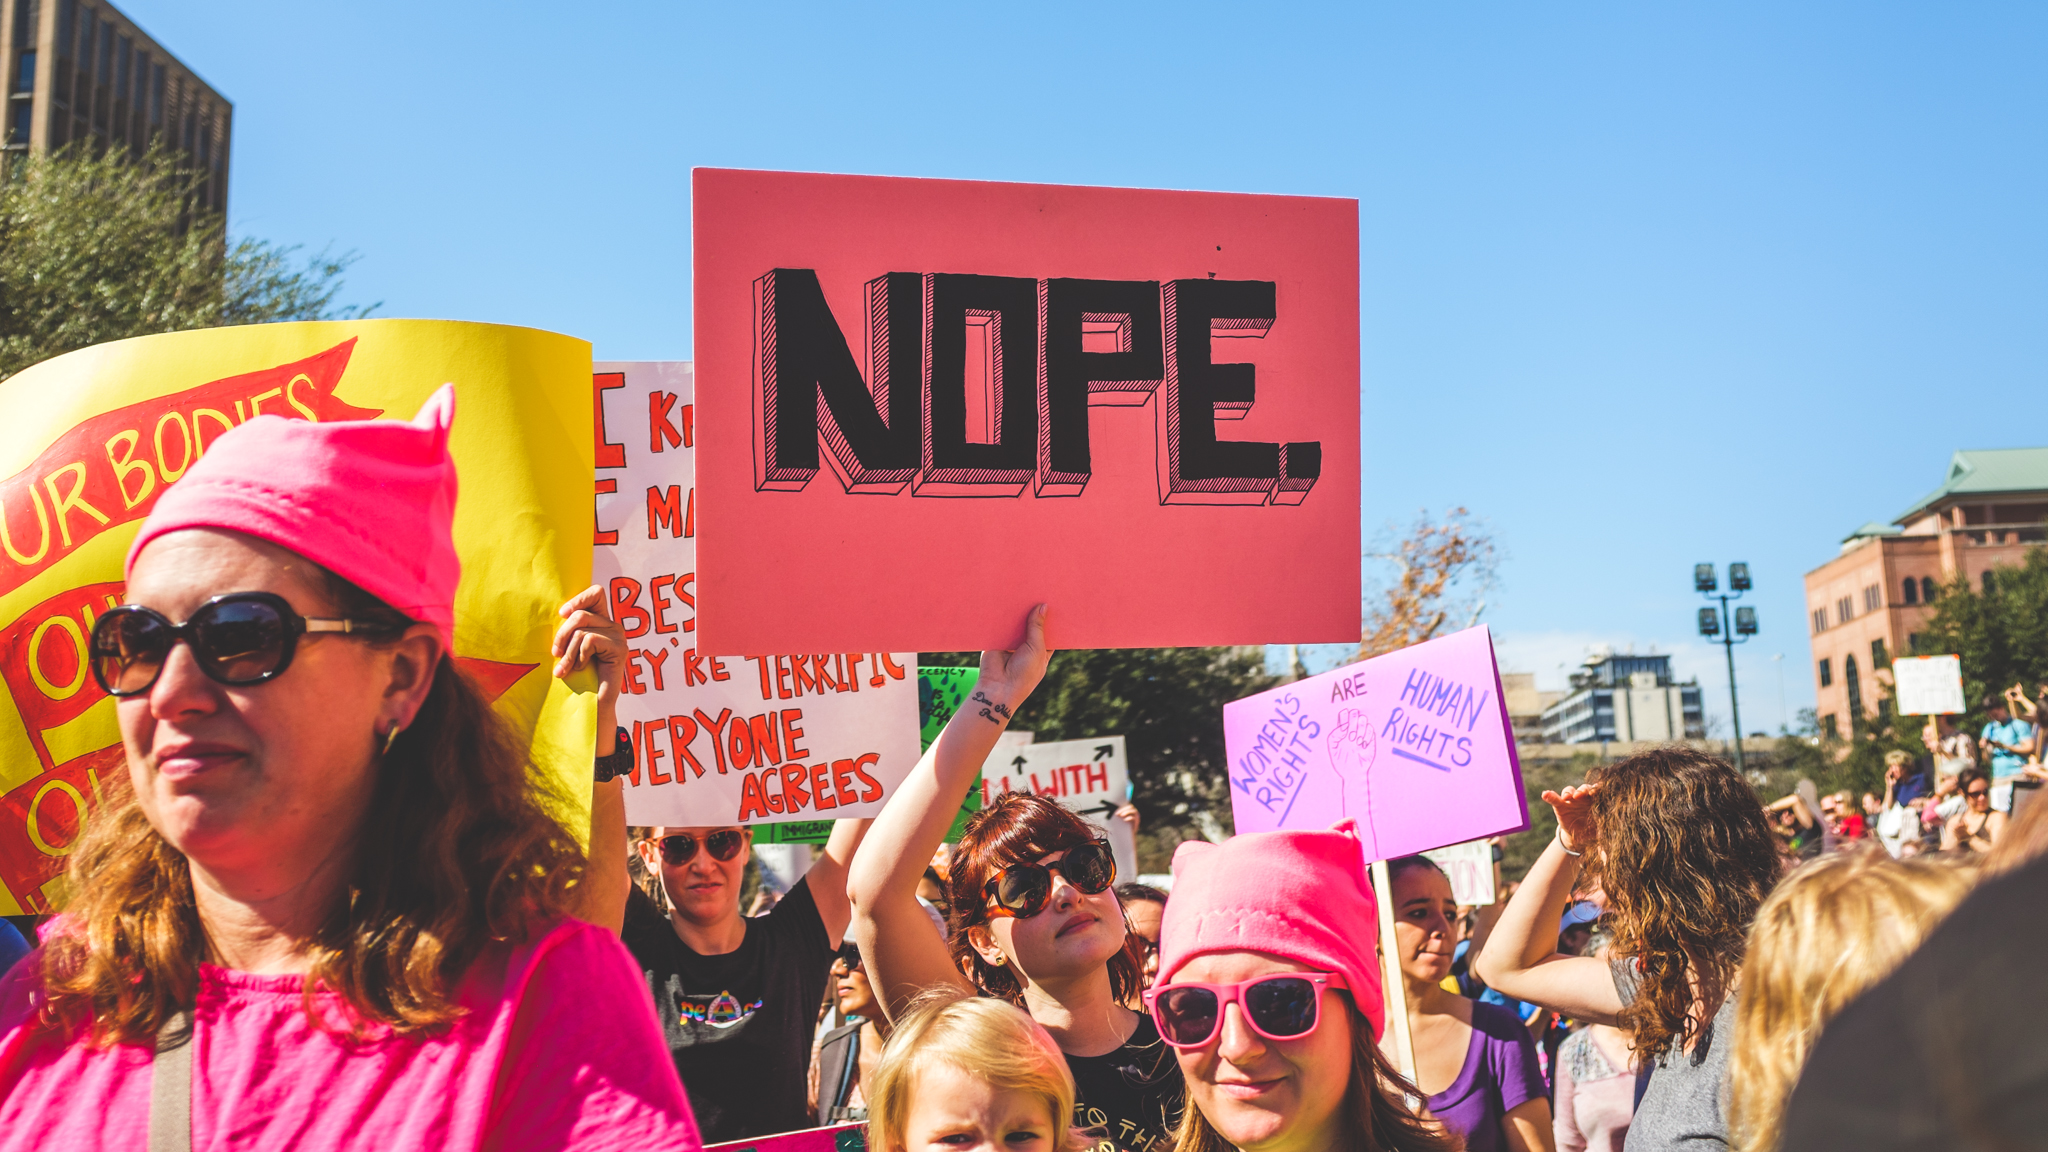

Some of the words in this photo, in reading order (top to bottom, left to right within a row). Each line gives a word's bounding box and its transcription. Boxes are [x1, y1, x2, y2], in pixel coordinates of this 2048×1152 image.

[753, 267, 1321, 506] NOPE.
[104, 373, 318, 510] BODS
[745, 653, 905, 700] TERRIFIC
[1331, 672, 1368, 703] ARE
[1400, 667, 1489, 732] HUMAN
[1231, 692, 1300, 795] WOMEN'S
[1256, 715, 1321, 813] RIGHTS
[1382, 707, 1473, 767] RIGHTS
[738, 752, 884, 822] AGREES
[1030, 762, 1107, 797] WITH
